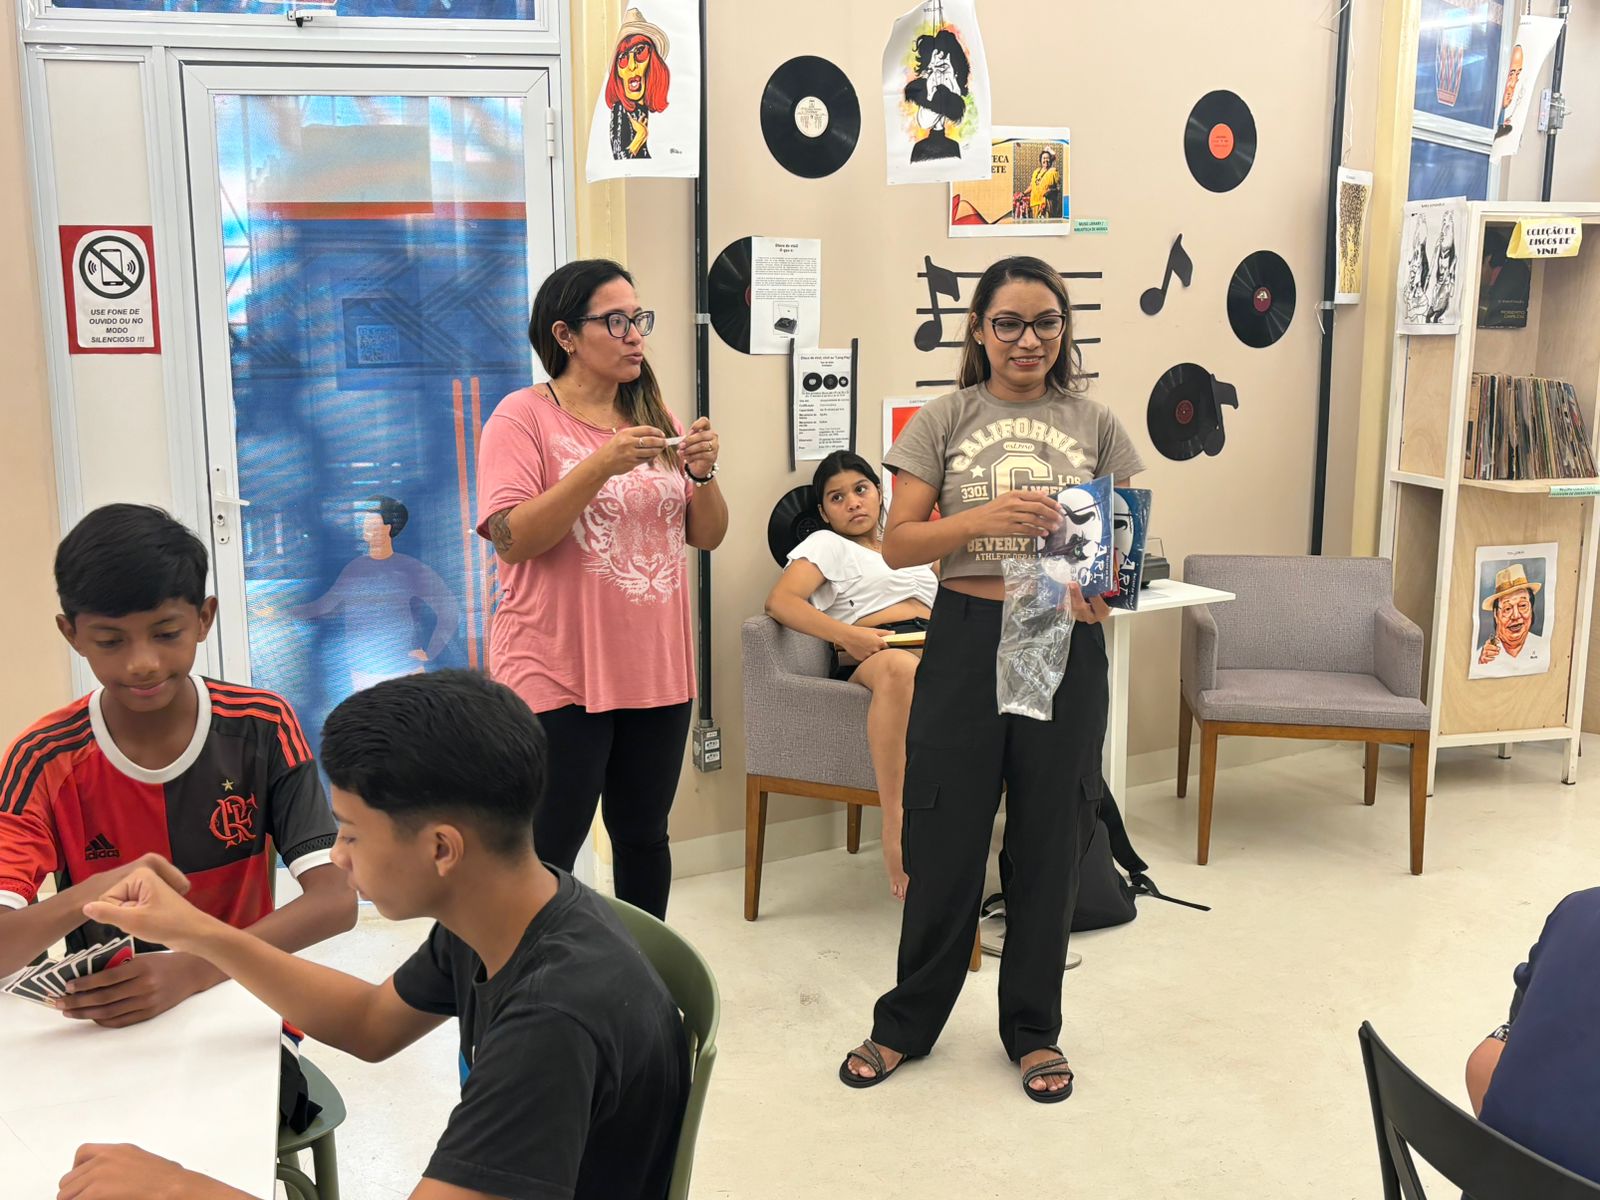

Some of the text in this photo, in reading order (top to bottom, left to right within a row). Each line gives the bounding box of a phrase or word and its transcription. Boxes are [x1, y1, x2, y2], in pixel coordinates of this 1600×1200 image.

[1526, 226, 1576, 236] COLEÇÃO DE
[952, 417, 1087, 472] CALIFORNIA
[961, 485, 988, 499] 3301
[85, 849, 119, 861] adidas
